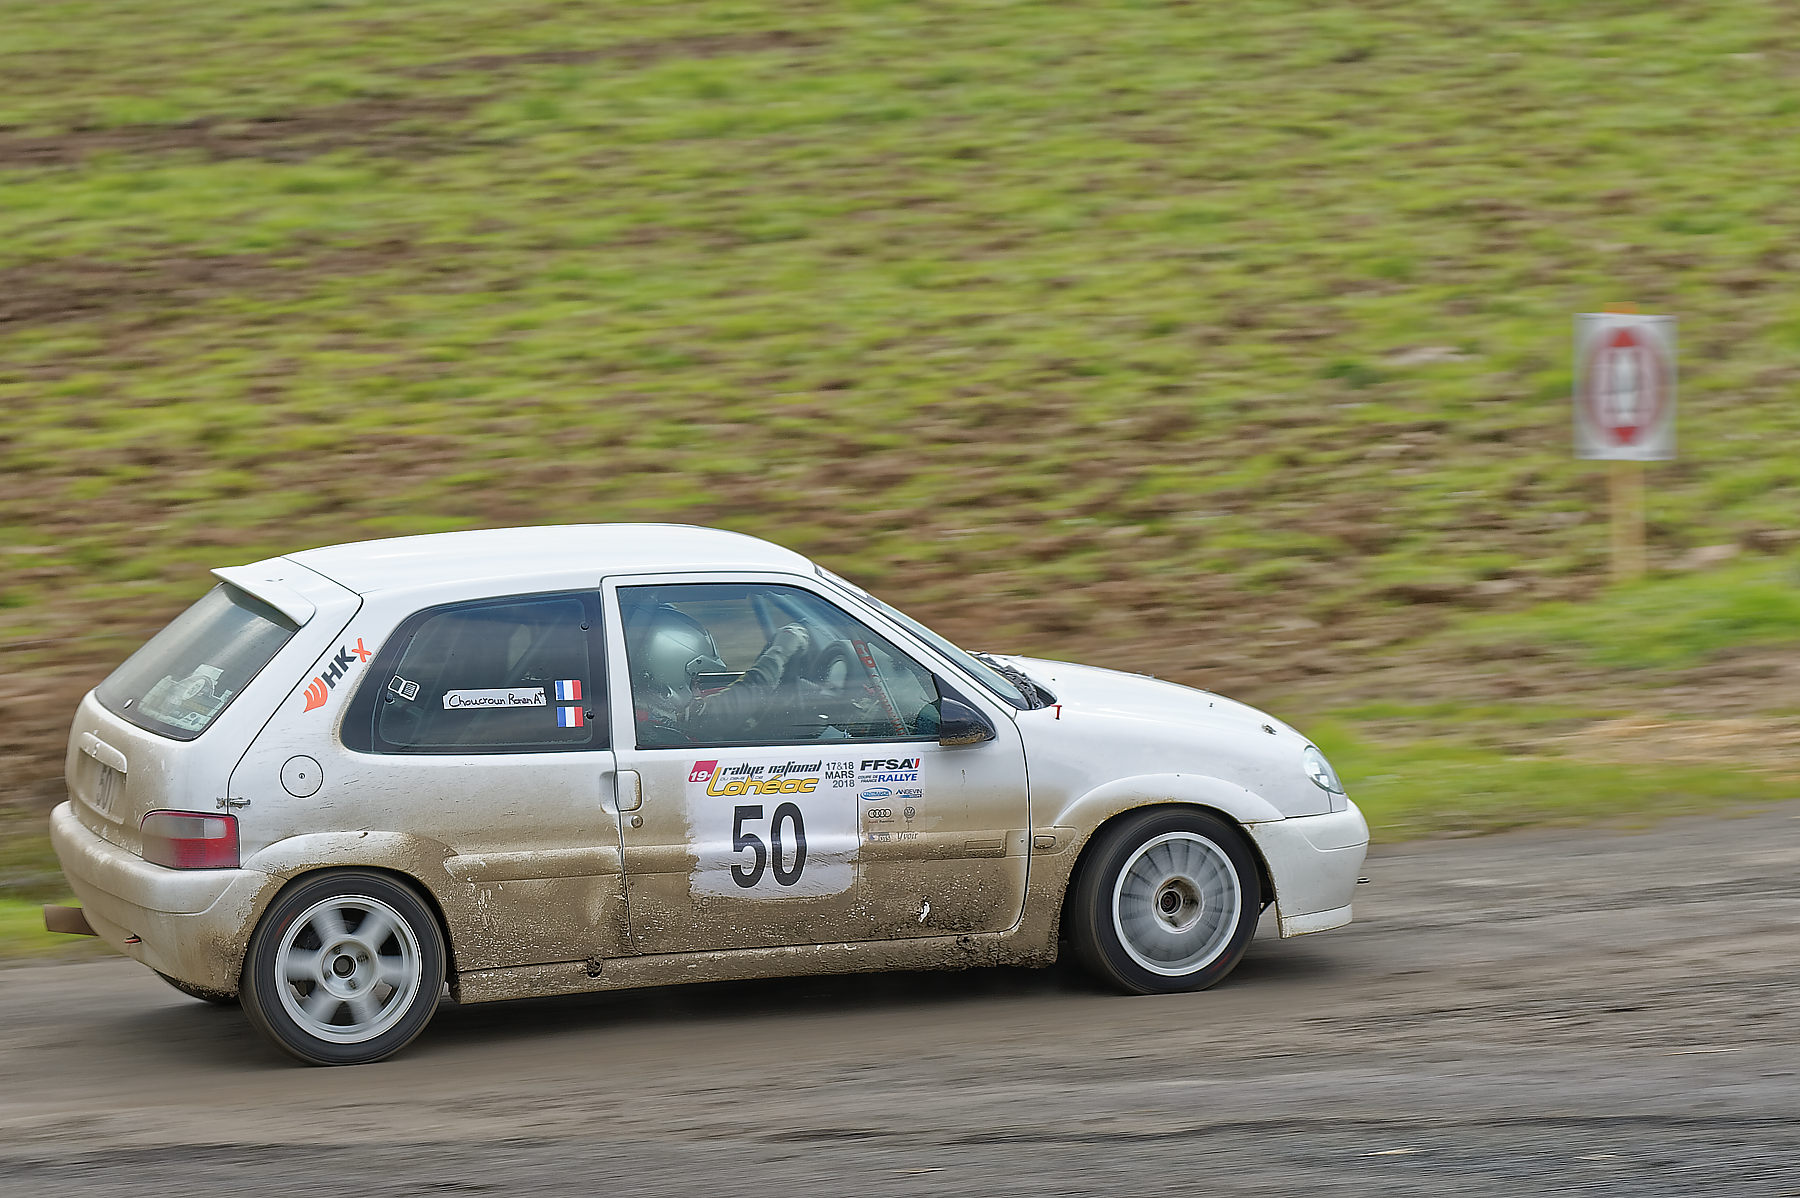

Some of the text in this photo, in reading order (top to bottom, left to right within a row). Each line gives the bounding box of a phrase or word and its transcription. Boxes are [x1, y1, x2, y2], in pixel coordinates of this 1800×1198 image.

[722, 762, 765, 779] rallye
[768, 759, 823, 778] national
[825, 761, 855, 771] 17&18
[825, 770, 855, 780] MARS
[877, 773, 918, 783] RALLYE
[706, 767, 820, 797] Lohéac
[832, 779, 856, 788] 2018
[731, 802, 808, 889] 50
